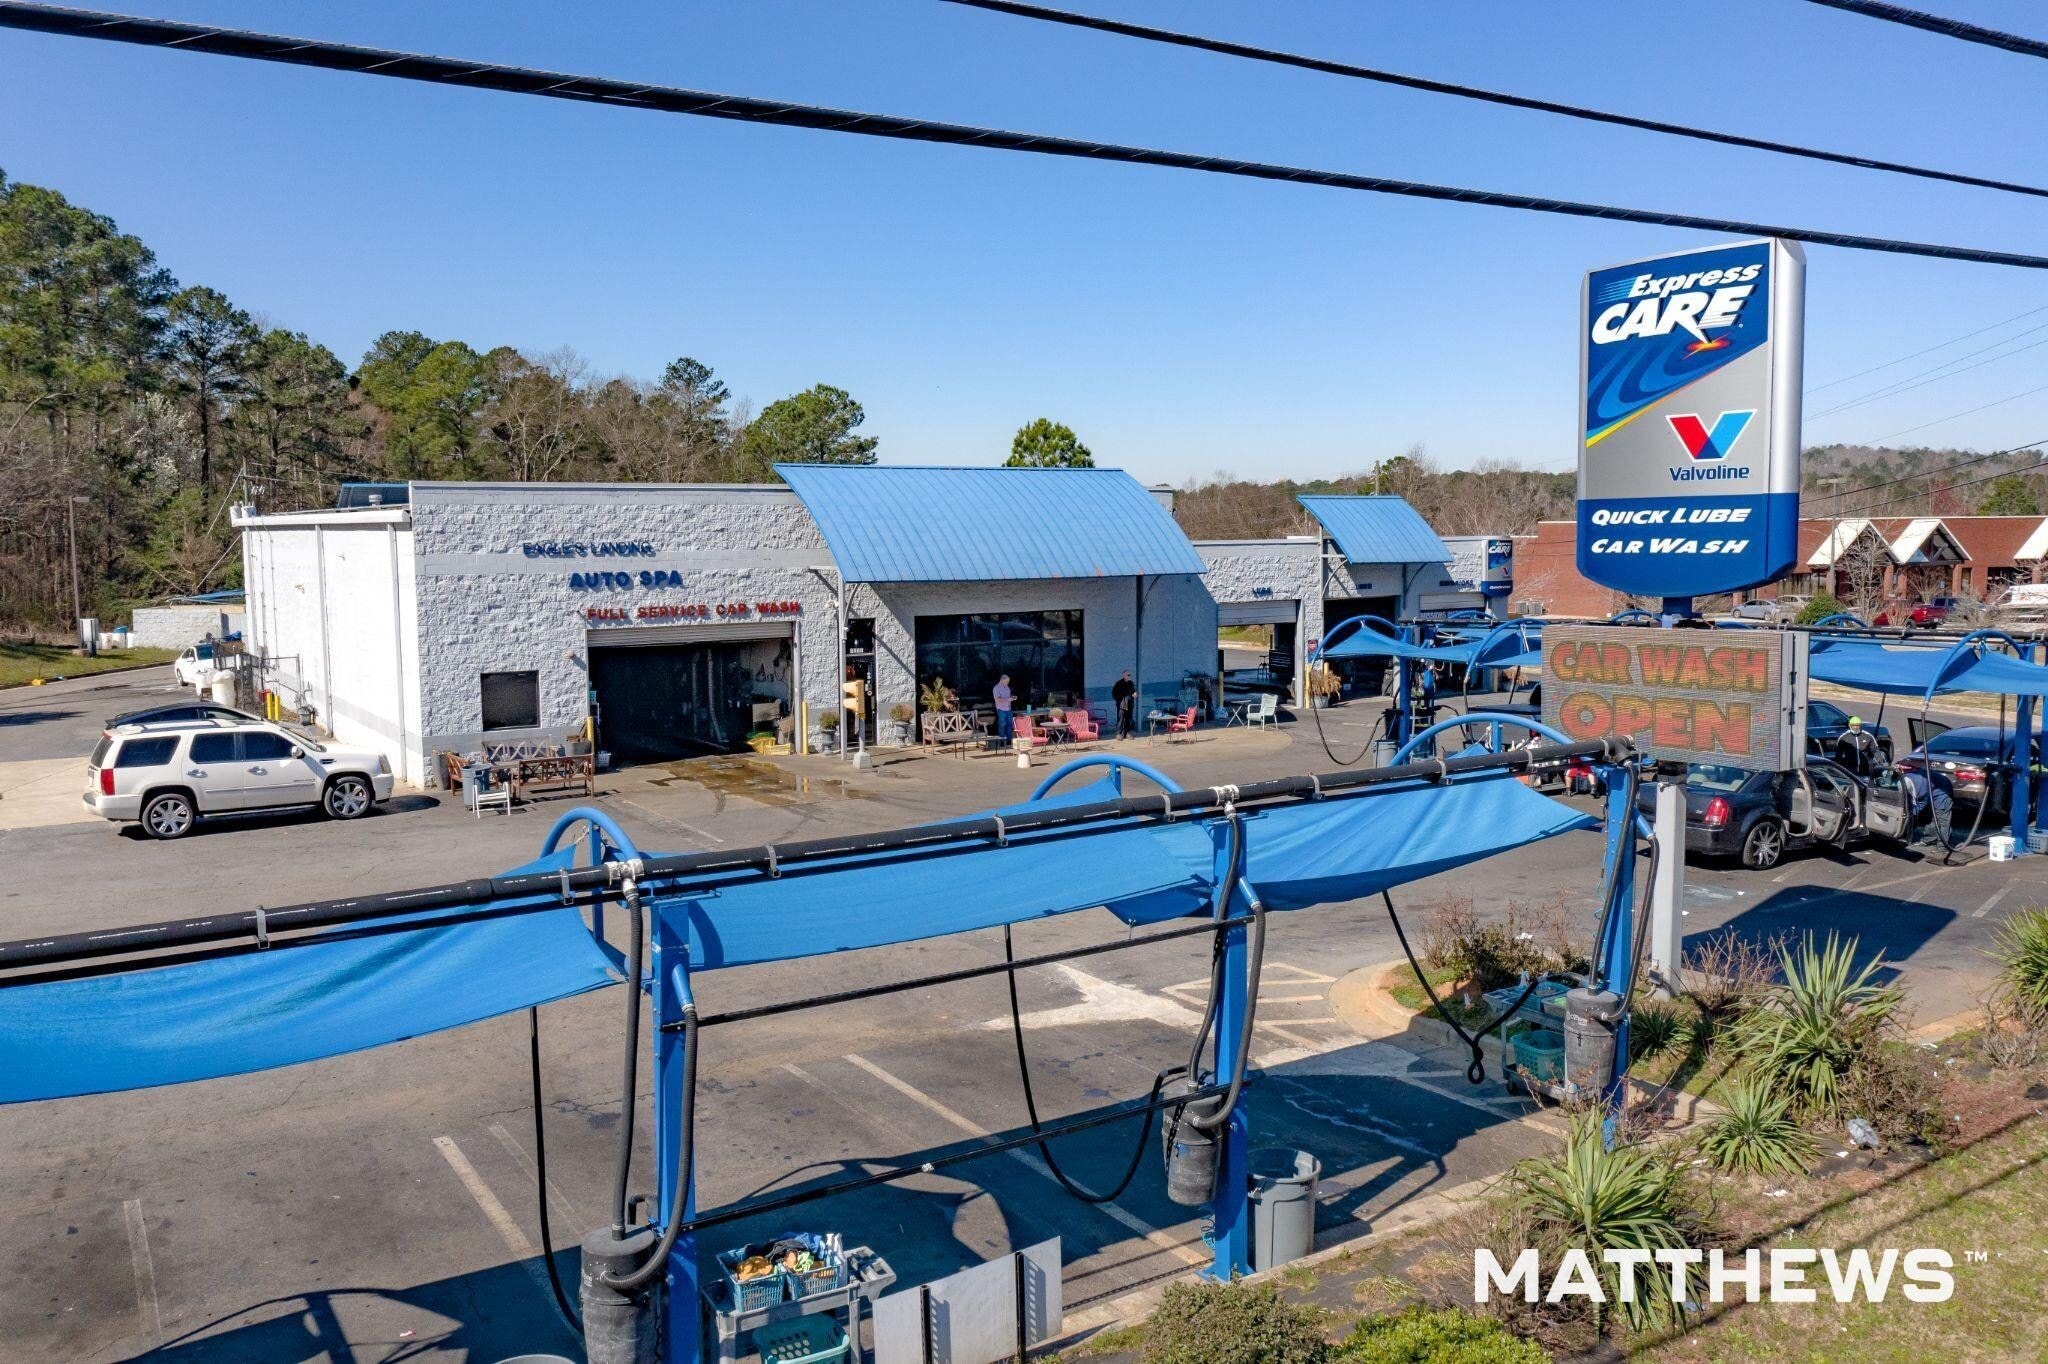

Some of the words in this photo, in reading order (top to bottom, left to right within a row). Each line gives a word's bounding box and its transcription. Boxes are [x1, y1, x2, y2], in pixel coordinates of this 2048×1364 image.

[1628, 264, 1763, 299] Express
[1591, 284, 1756, 345] CARE
[1669, 465, 1749, 481] Valvoline
[1591, 508, 1669, 526] QUICK
[1671, 506, 1752, 524] LUBE
[1591, 538, 1642, 555] CAR
[1650, 537, 1749, 555] WASH
[569, 571, 631, 588] AUTO
[639, 570, 683, 587] SPA
[587, 607, 627, 621] FULL
[636, 604, 708, 619] SERVICE
[716, 603, 749, 616] CAR
[756, 601, 800, 615] WASH
[1551, 641, 1631, 684] CAR
[1639, 644, 1768, 692] WASH
[1560, 692, 1750, 755] OPEN
